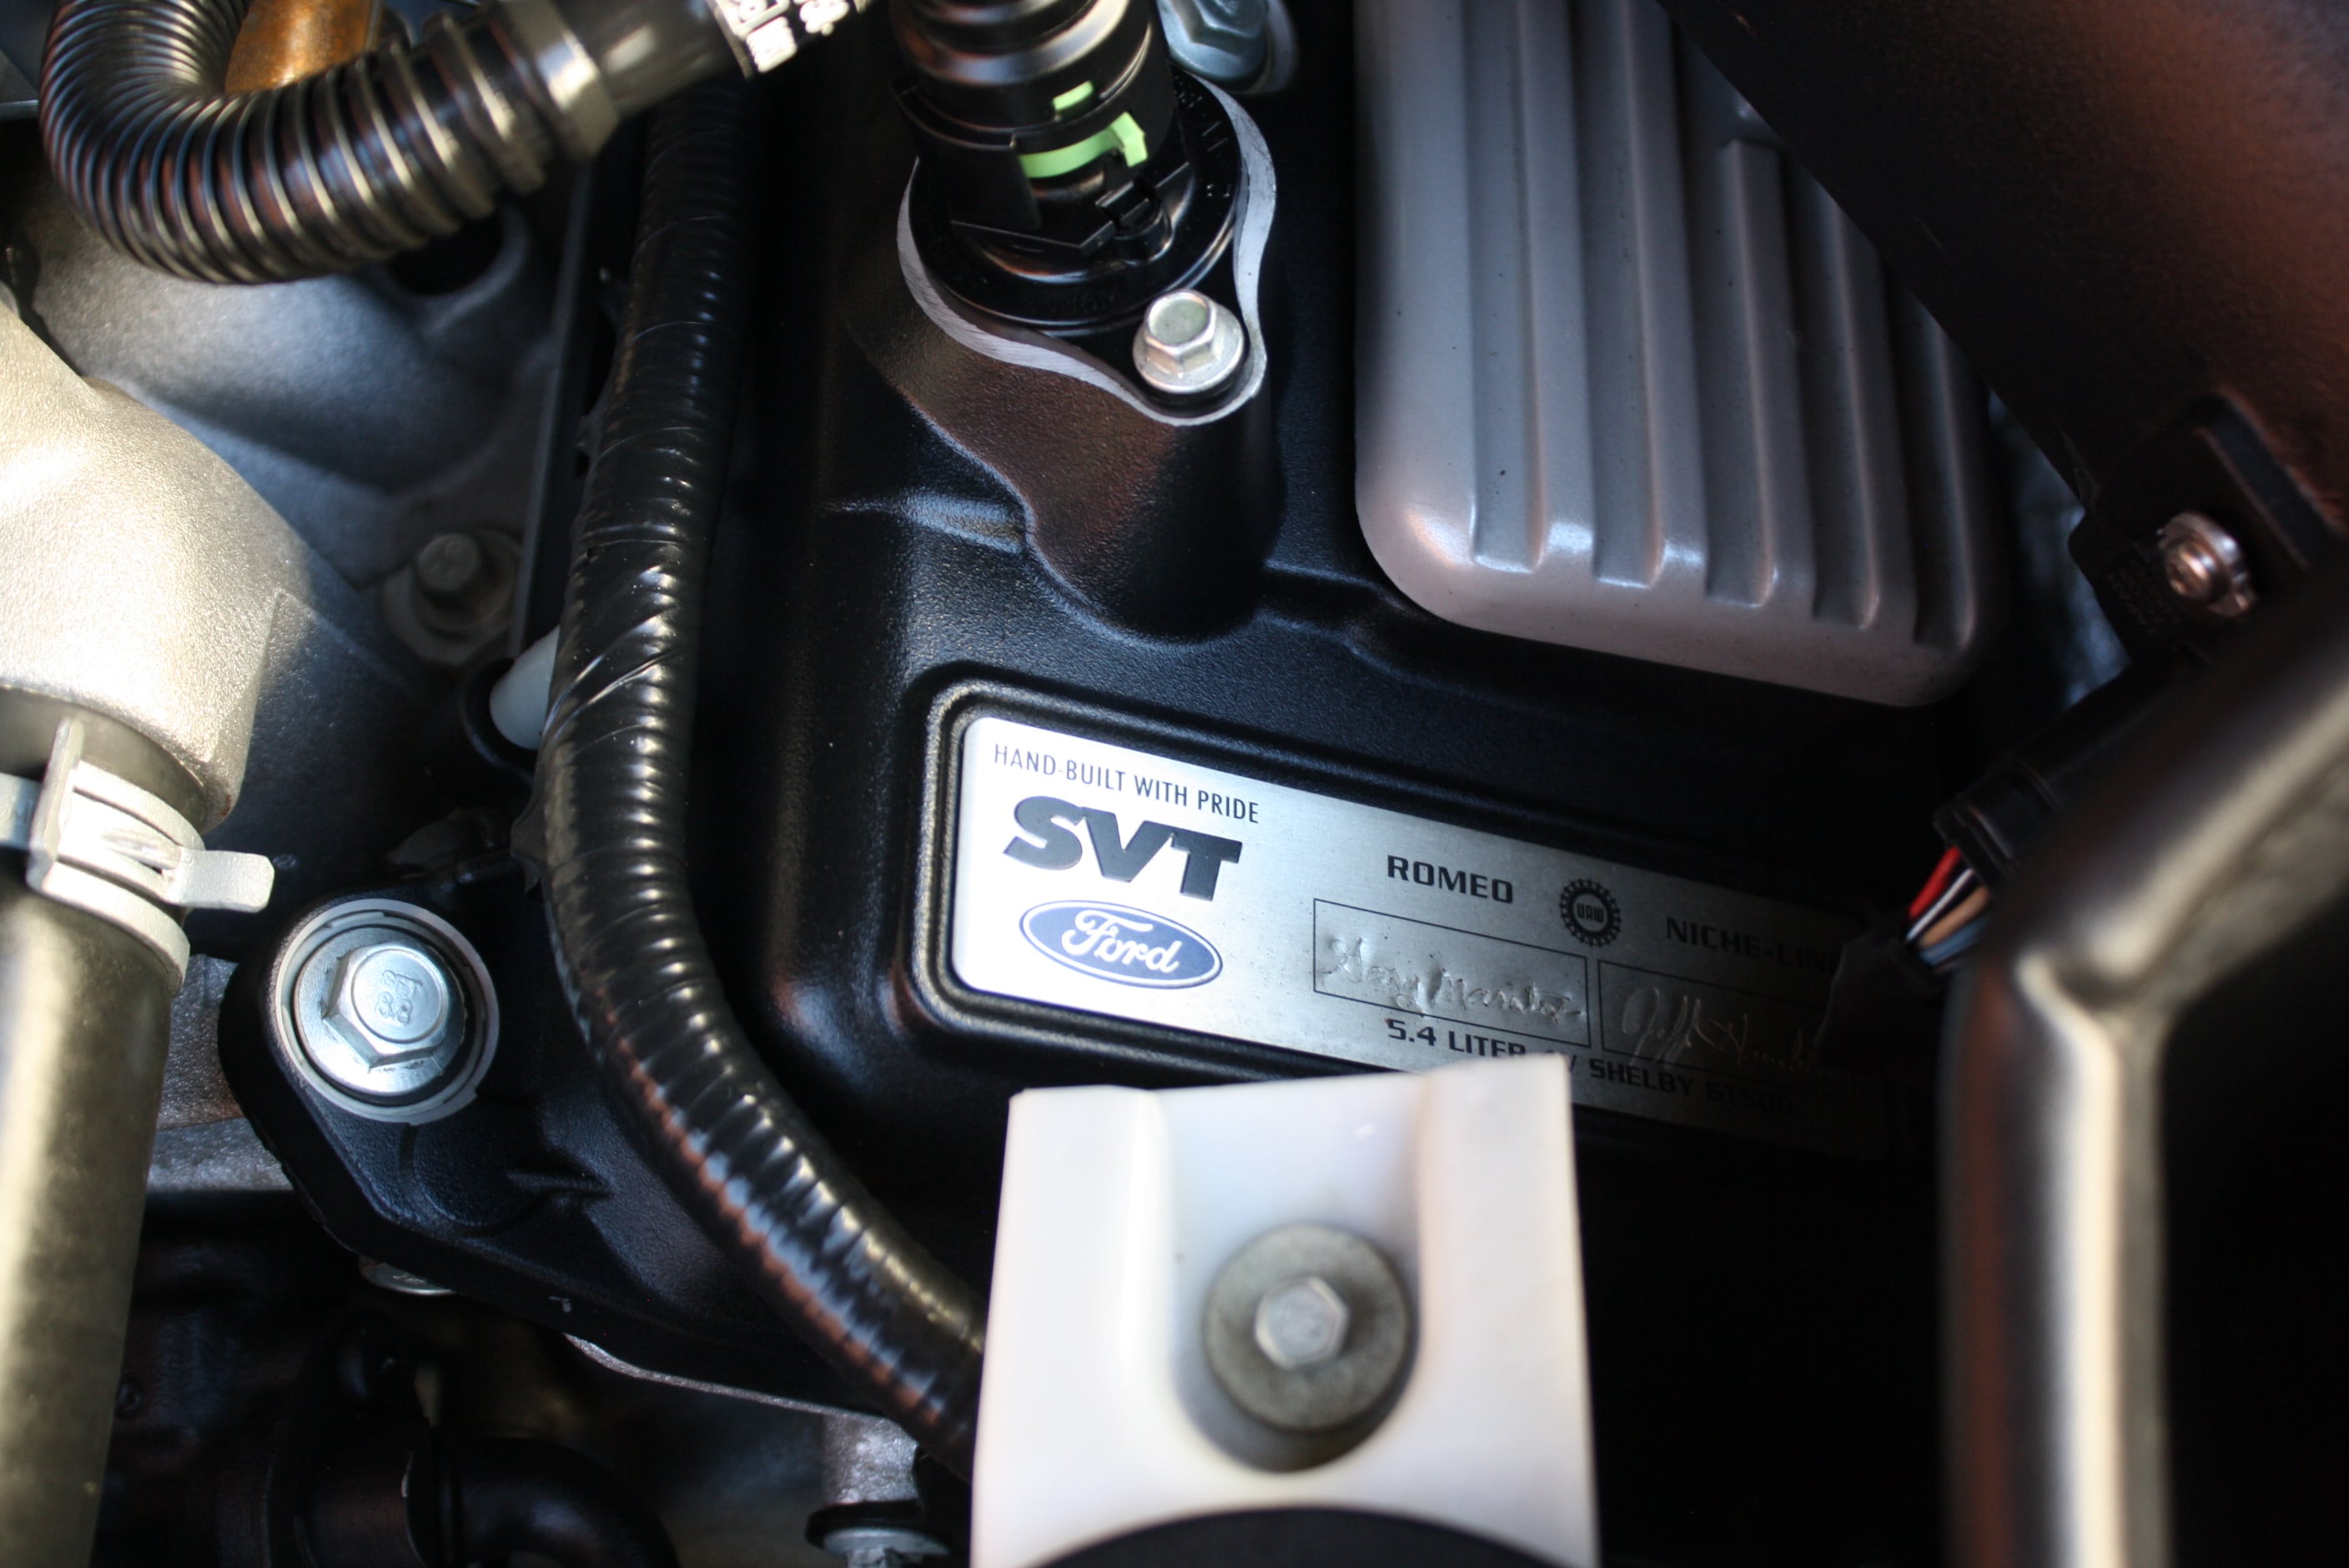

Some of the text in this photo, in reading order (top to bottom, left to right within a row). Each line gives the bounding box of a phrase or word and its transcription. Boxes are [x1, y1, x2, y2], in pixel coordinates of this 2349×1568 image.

[994, 743, 1259, 823] HAND-BUILT WITH PRIDE
[1003, 796, 1243, 902] SVT
[1388, 855, 1513, 904] ROMEO
[1061, 909, 1183, 973] Ford
[1577, 903, 1603, 922] UAW
[1388, 1018, 1436, 1046] 5.4
[1589, 1058, 1693, 1096] SHELBY
[1707, 1081, 1793, 1116] GT500
